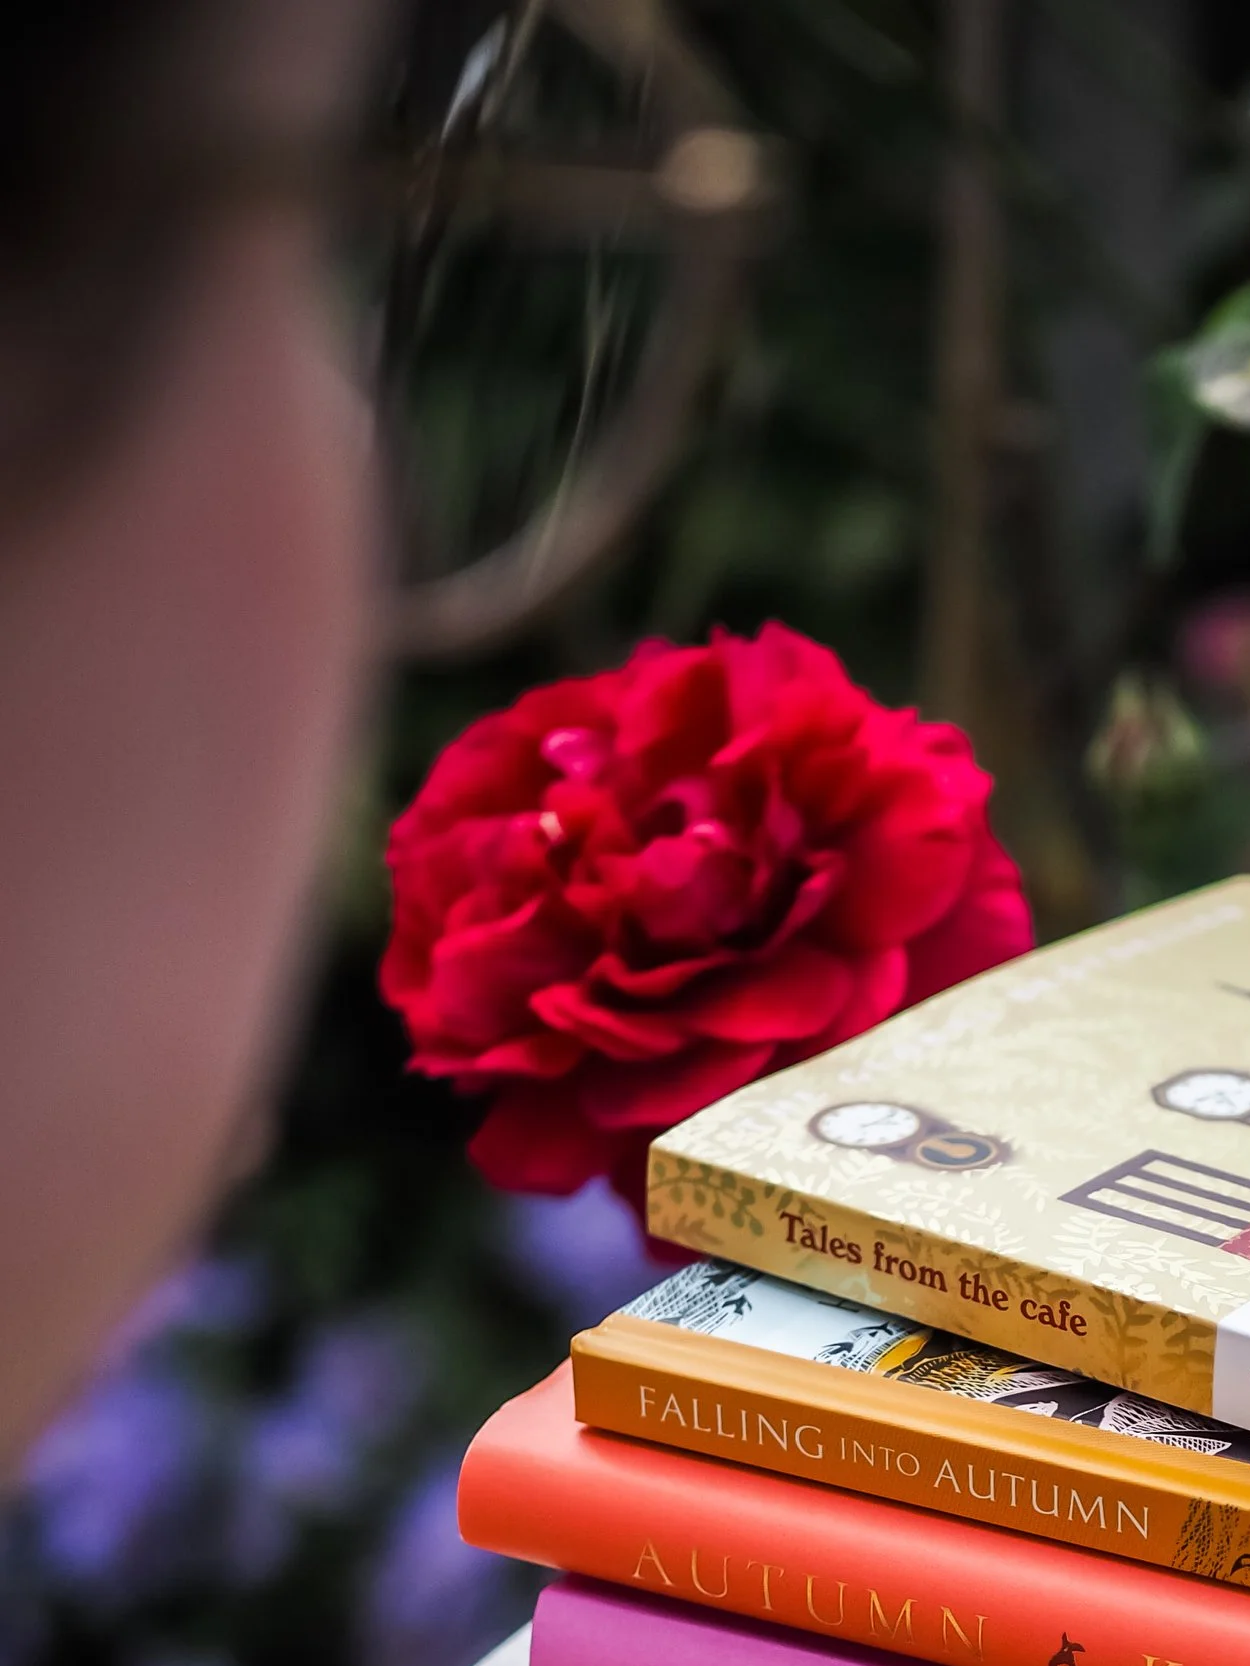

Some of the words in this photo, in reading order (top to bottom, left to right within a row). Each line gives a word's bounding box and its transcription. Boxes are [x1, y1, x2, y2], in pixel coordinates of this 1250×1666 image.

[779, 1212, 862, 1265] Tales
[873, 1241, 948, 1294] from
[959, 1272, 1010, 1312] the
[1020, 1297, 1088, 1337] cafe
[638, 1385, 824, 1460] FALLING
[840, 1437, 920, 1478] INTO
[933, 1458, 1150, 1540] AUTUMN
[632, 1538, 990, 1661] AUTUMN
